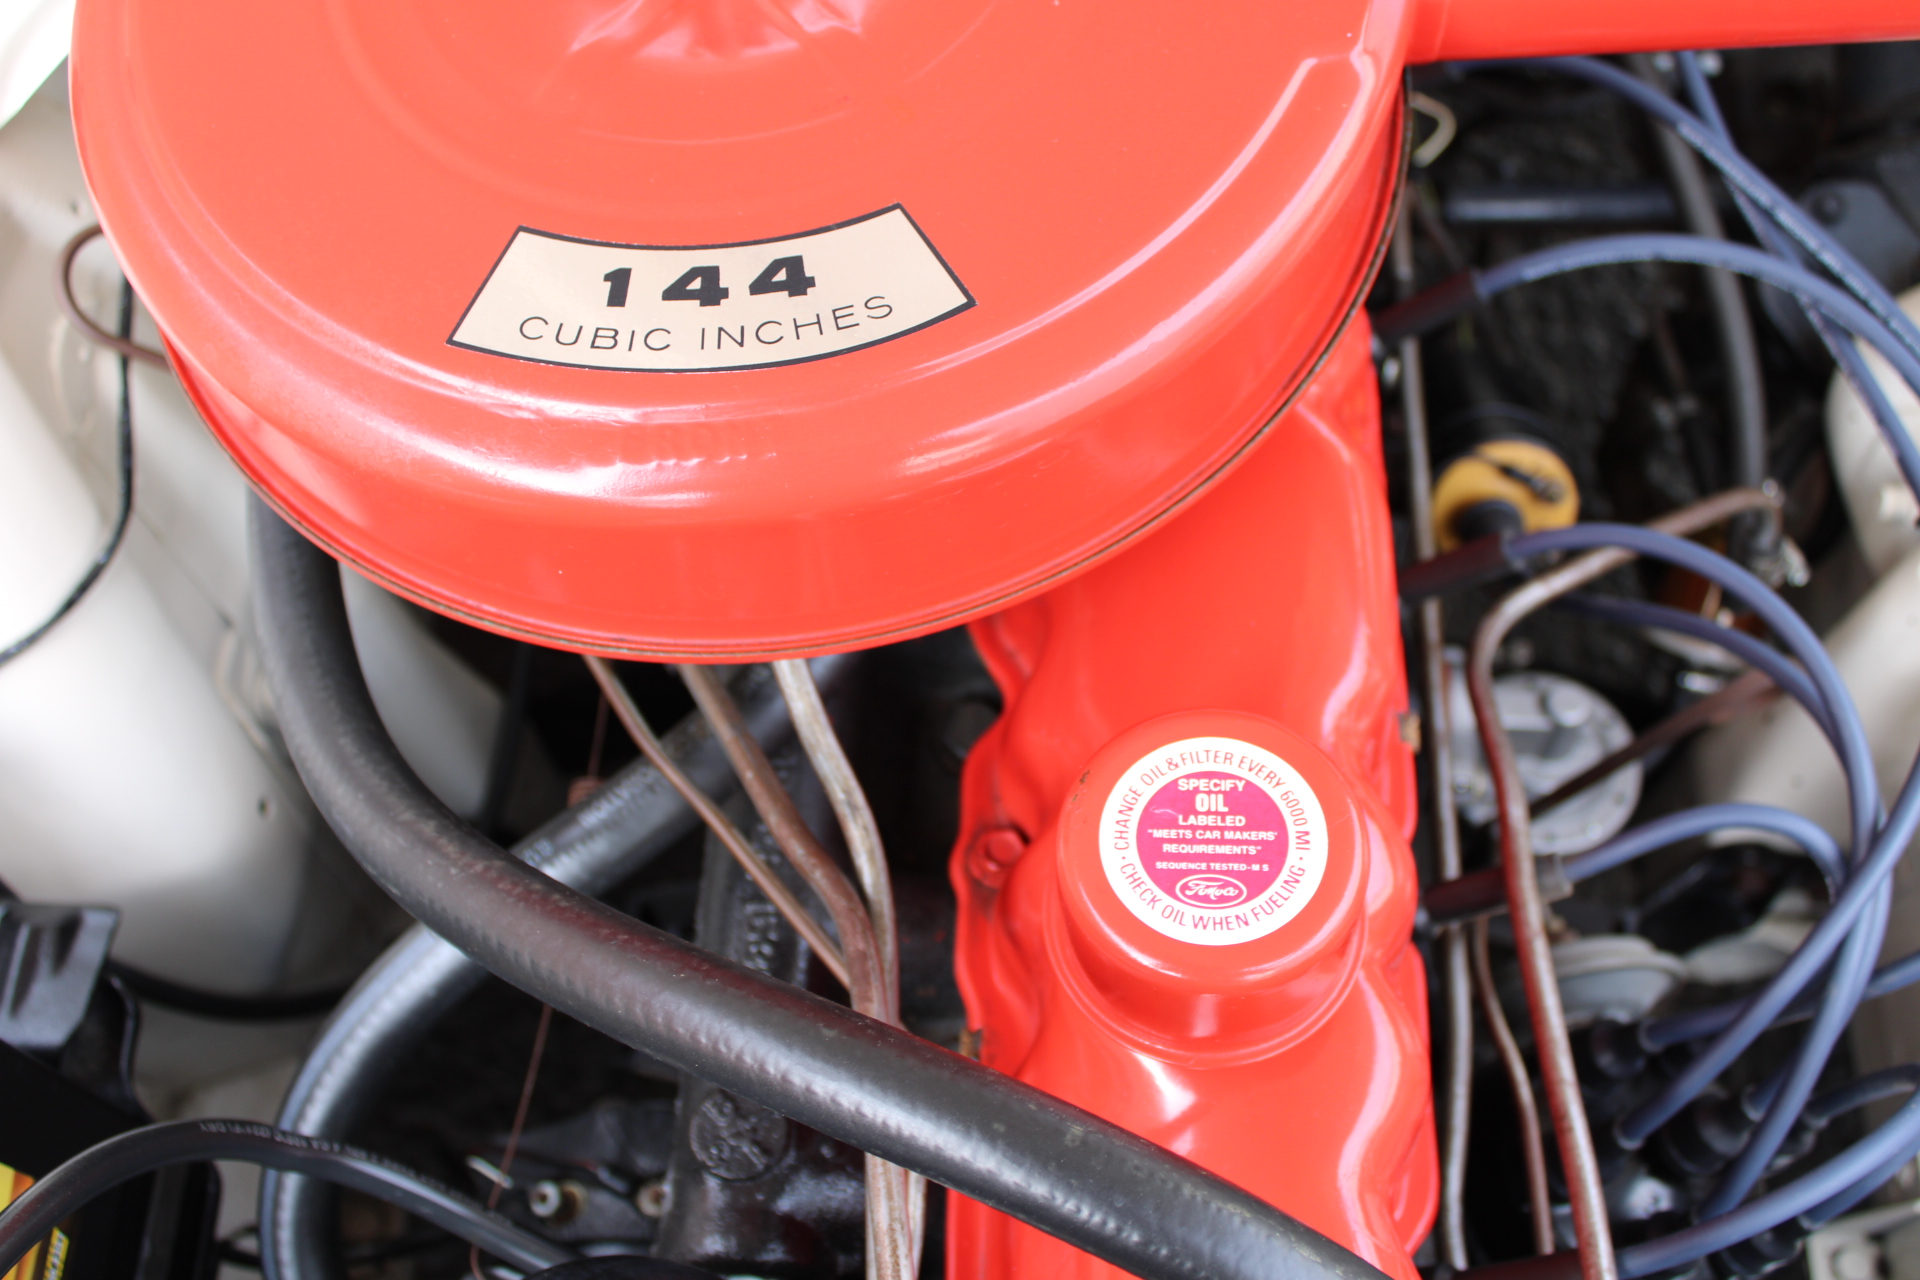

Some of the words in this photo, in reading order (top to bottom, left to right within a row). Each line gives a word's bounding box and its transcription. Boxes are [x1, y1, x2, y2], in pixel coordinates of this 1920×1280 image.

[603, 254, 816, 307] 144
[519, 316, 672, 352] CUBIC
[700, 295, 894, 351] INCHES
[1177, 778, 1246, 792] SPECIFY
[1114, 786, 1144, 850] CHANGE
[1140, 765, 1168, 786] OIL
[1179, 749, 1234, 766] FILTER
[1238, 756, 1287, 789] EVERY
[1280, 790, 1308, 826] 6000
[1295, 830, 1311, 850] MI
[1195, 793, 1229, 812] OIL
[1178, 815, 1246, 827] LABELED
[1195, 830, 1221, 840] CAR
[1155, 861, 1208, 870] SEQUENCE
[1120, 863, 1163, 910] CHECK
[1161, 904, 1187, 927] OIL
[1192, 912, 1250, 931] WHEN
[1250, 865, 1306, 922] FUELING
